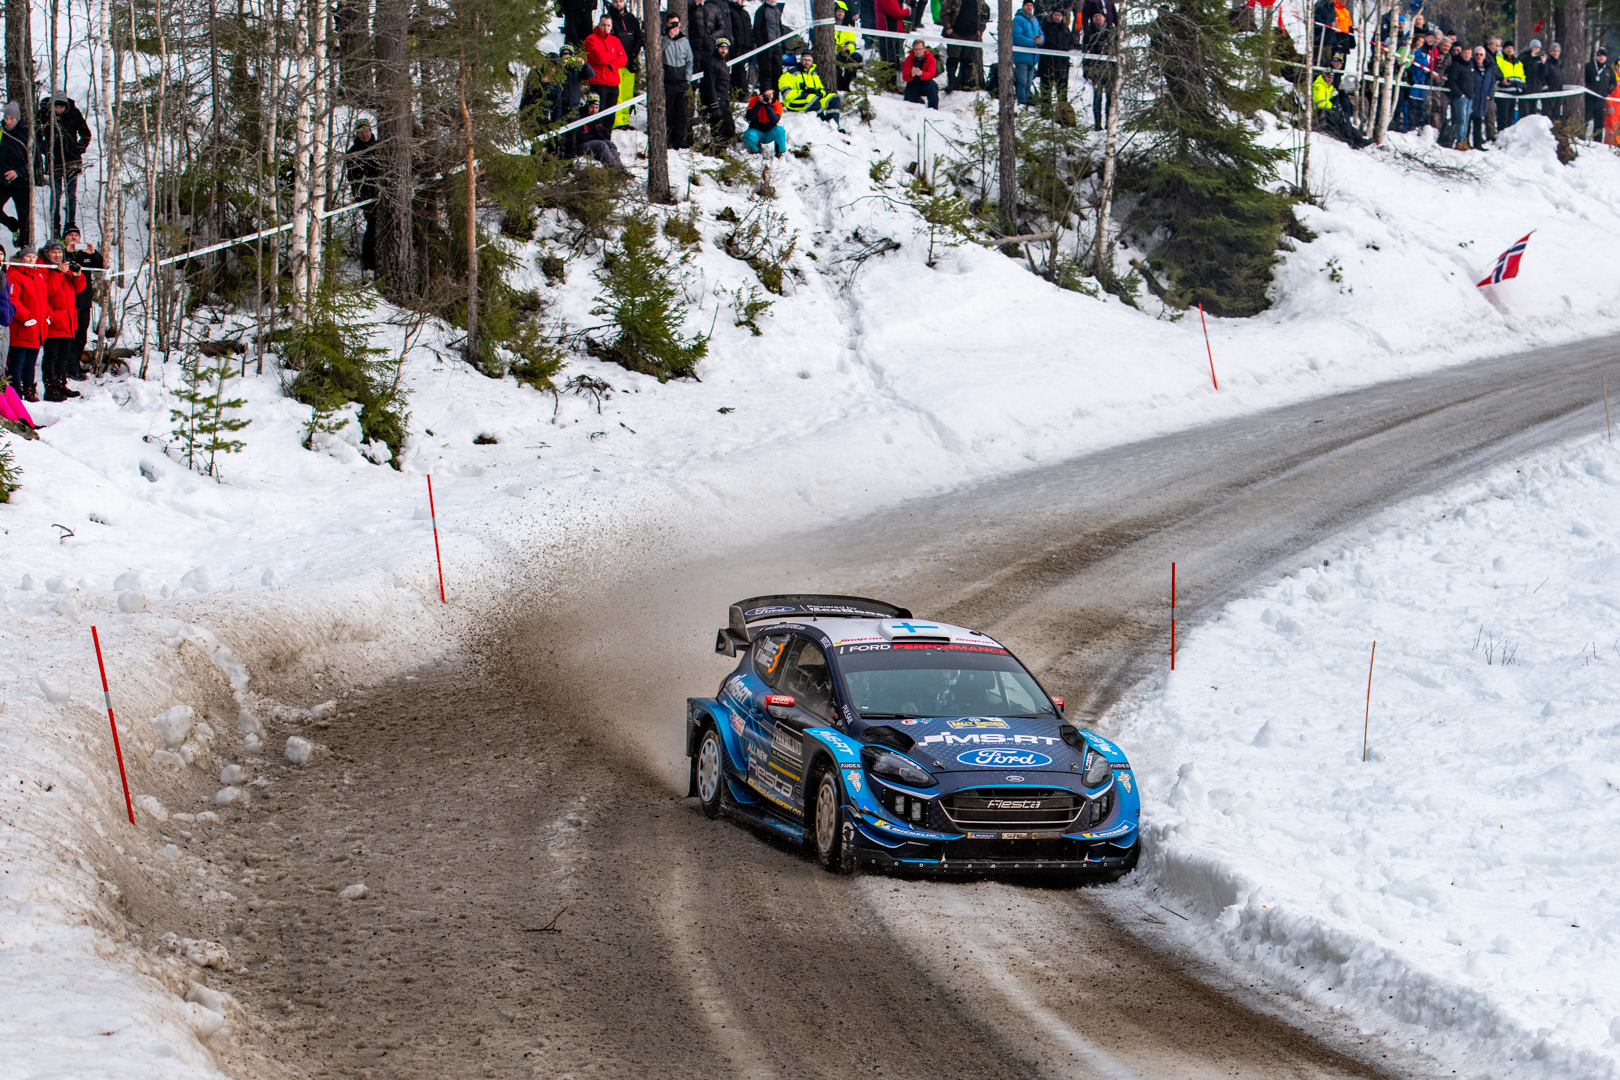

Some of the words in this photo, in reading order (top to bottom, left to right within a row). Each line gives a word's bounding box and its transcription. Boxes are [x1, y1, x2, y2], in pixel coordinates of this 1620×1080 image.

[755, 606, 787, 614] Ford
[849, 644, 891, 652] FORD
[893, 642, 1008, 655] PERFORMANCE
[767, 643, 784, 673] 3
[943, 733, 1061, 745] MS-RT
[747, 742, 757, 757] ALL
[756, 747, 769, 762] NEW
[975, 749, 1037, 765] Ford
[747, 756, 793, 799] Fiesta
[986, 799, 1041, 809] Fiesta
[891, 827, 937, 838] MICHELIN
[1099, 824, 1129, 837] MICHELIN
